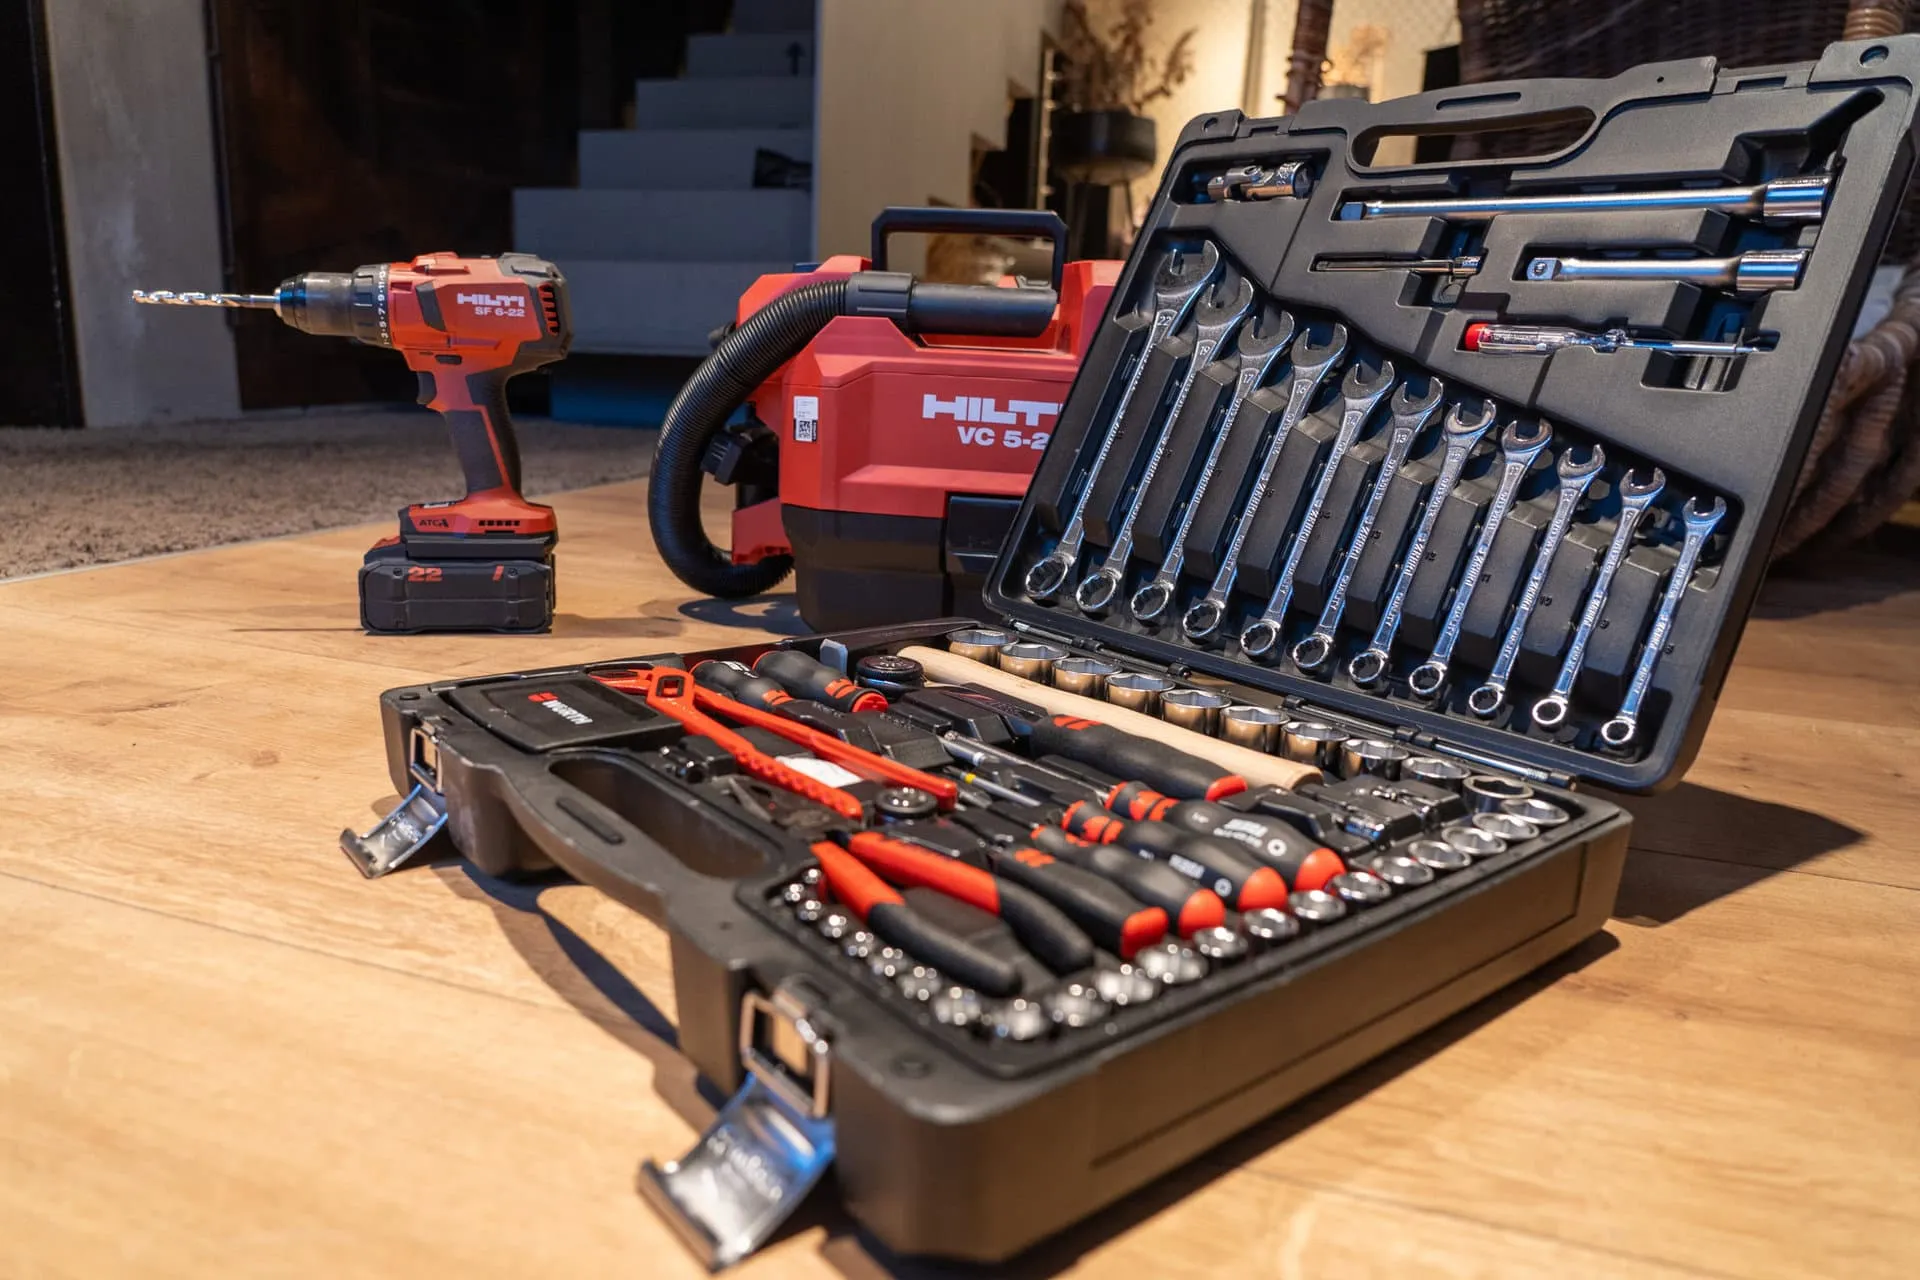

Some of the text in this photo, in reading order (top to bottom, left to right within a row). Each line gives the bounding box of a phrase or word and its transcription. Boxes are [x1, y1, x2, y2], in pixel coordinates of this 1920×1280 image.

[457, 293, 525, 307] HILTI
[475, 306, 525, 317] SF 6-22
[1157, 315, 1172, 326] 22
[1199, 345, 1211, 356] 19
[1242, 373, 1255, 384] 17
[1295, 384, 1307, 395] 16
[922, 394, 1063, 426] HILT
[957, 426, 995, 445] VC
[408, 566, 443, 582] 22
